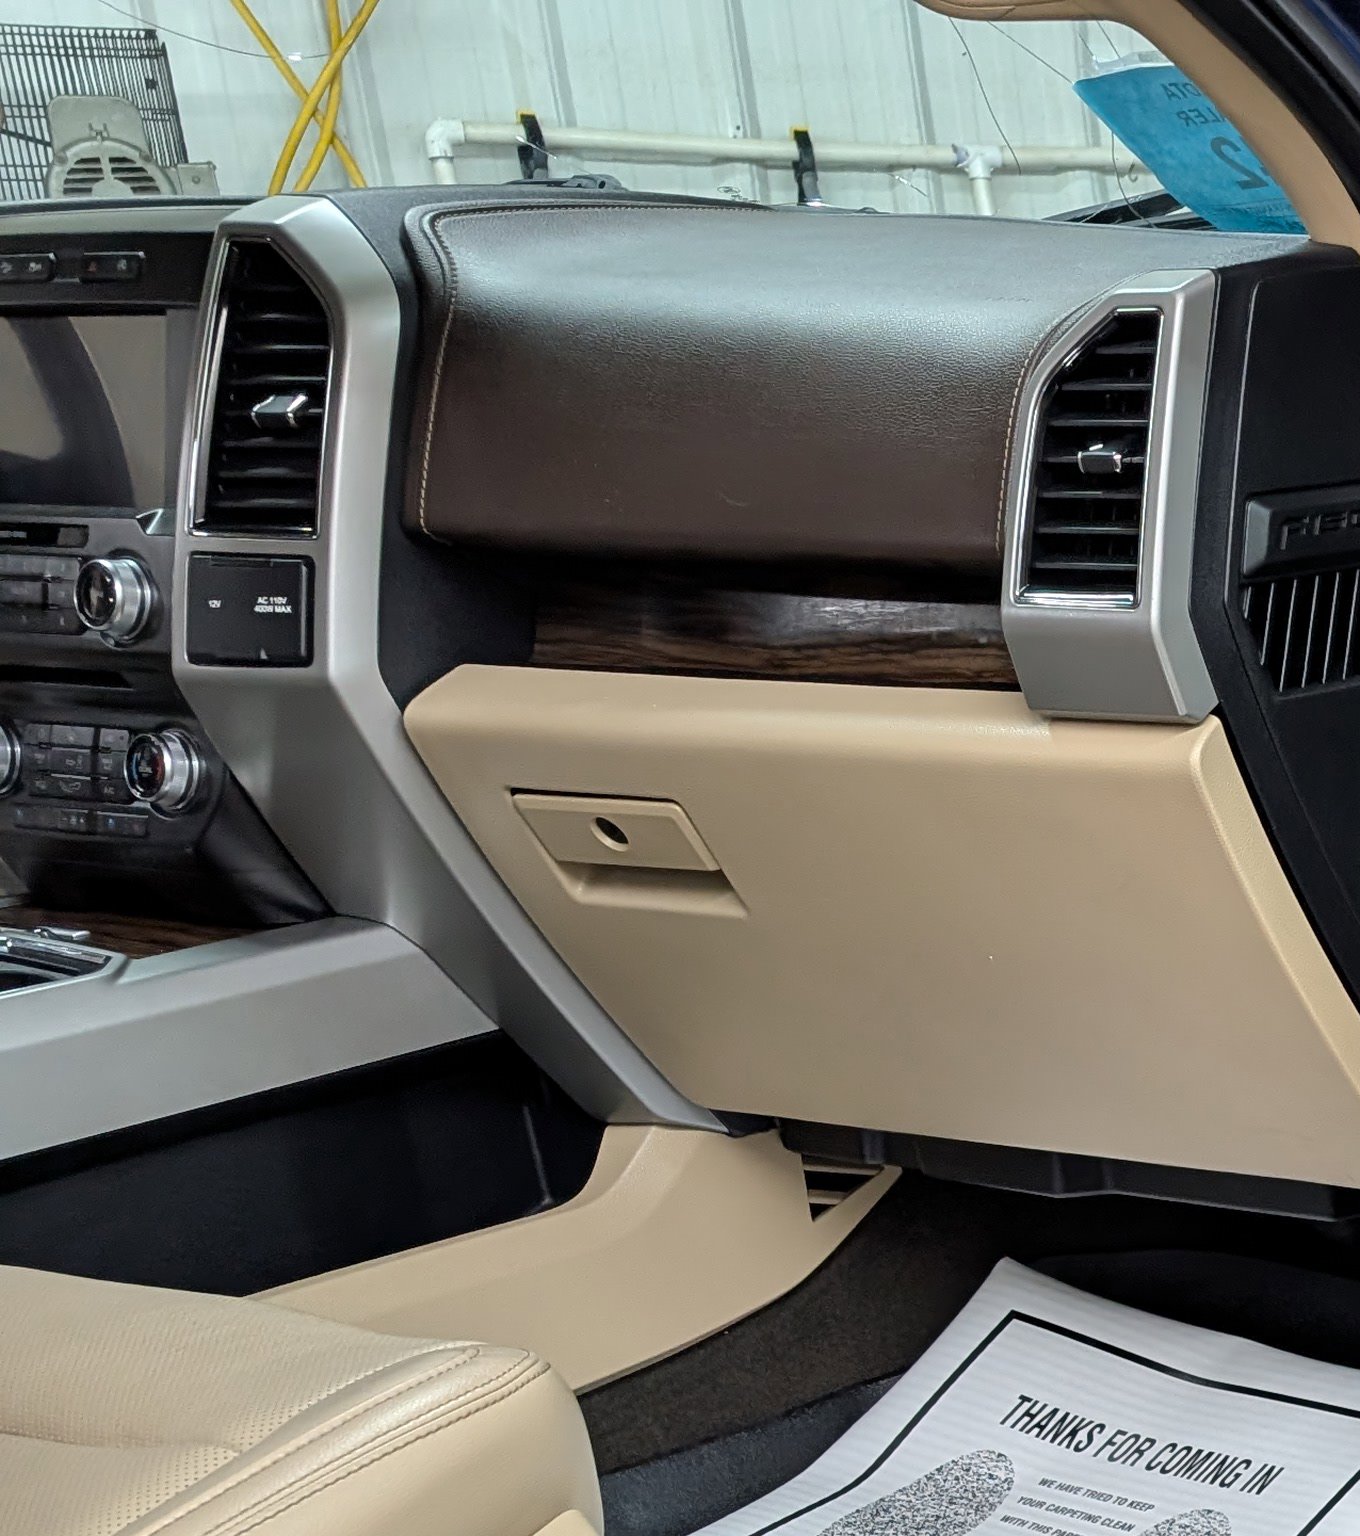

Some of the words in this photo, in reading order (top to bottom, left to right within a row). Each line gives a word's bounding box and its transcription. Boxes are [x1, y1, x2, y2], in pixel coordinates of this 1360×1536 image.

[257, 596, 269, 604] AC
[274, 605, 292, 613] MAX
[1000, 1394, 1106, 1453] THANKS
[1093, 1429, 1156, 1467] FOR
[1145, 1442, 1252, 1488] COMING
[1239, 1463, 1284, 1495] IN
[1038, 1478, 1057, 1488] WE
[1054, 1482, 1084, 1495] HAVE
[1082, 1489, 1113, 1502] TRIED
[1112, 1496, 1128, 1506] TO
[1126, 1500, 1155, 1512] KEEP
[1000, 1515, 1029, 1527] WITH
[1027, 1522, 1053, 1534] THIS
[1017, 1496, 1047, 1509] YOUR
[1045, 1503, 1102, 1523] CARPETING
[1101, 1518, 1136, 1532] CLEAN
